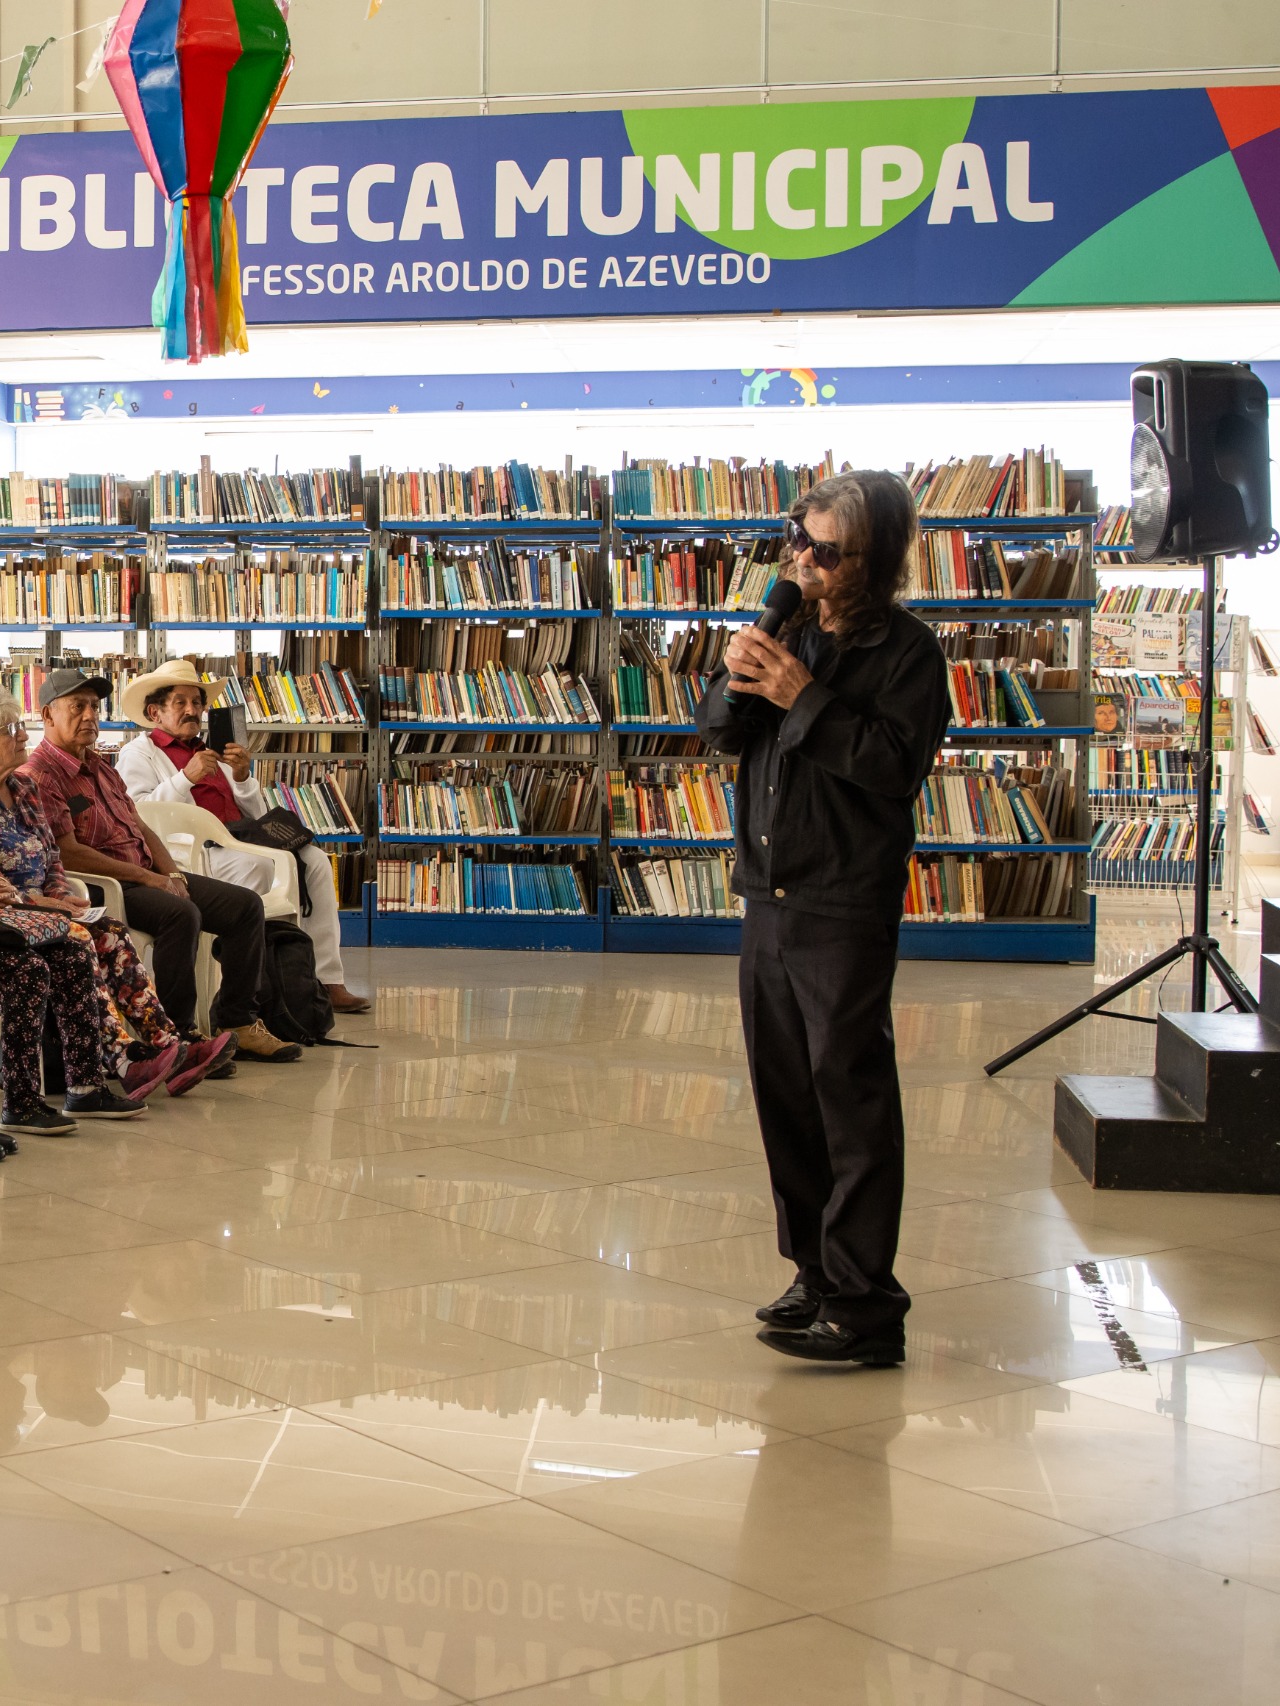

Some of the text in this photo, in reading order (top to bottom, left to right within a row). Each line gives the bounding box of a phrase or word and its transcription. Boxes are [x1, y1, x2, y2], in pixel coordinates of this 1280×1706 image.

[495, 141, 1054, 238] MUNICIPAL
[243, 252, 771, 297] FESSOR AROLDO DE AZEVEDO
[1139, 701, 1180, 710] Aparecida
